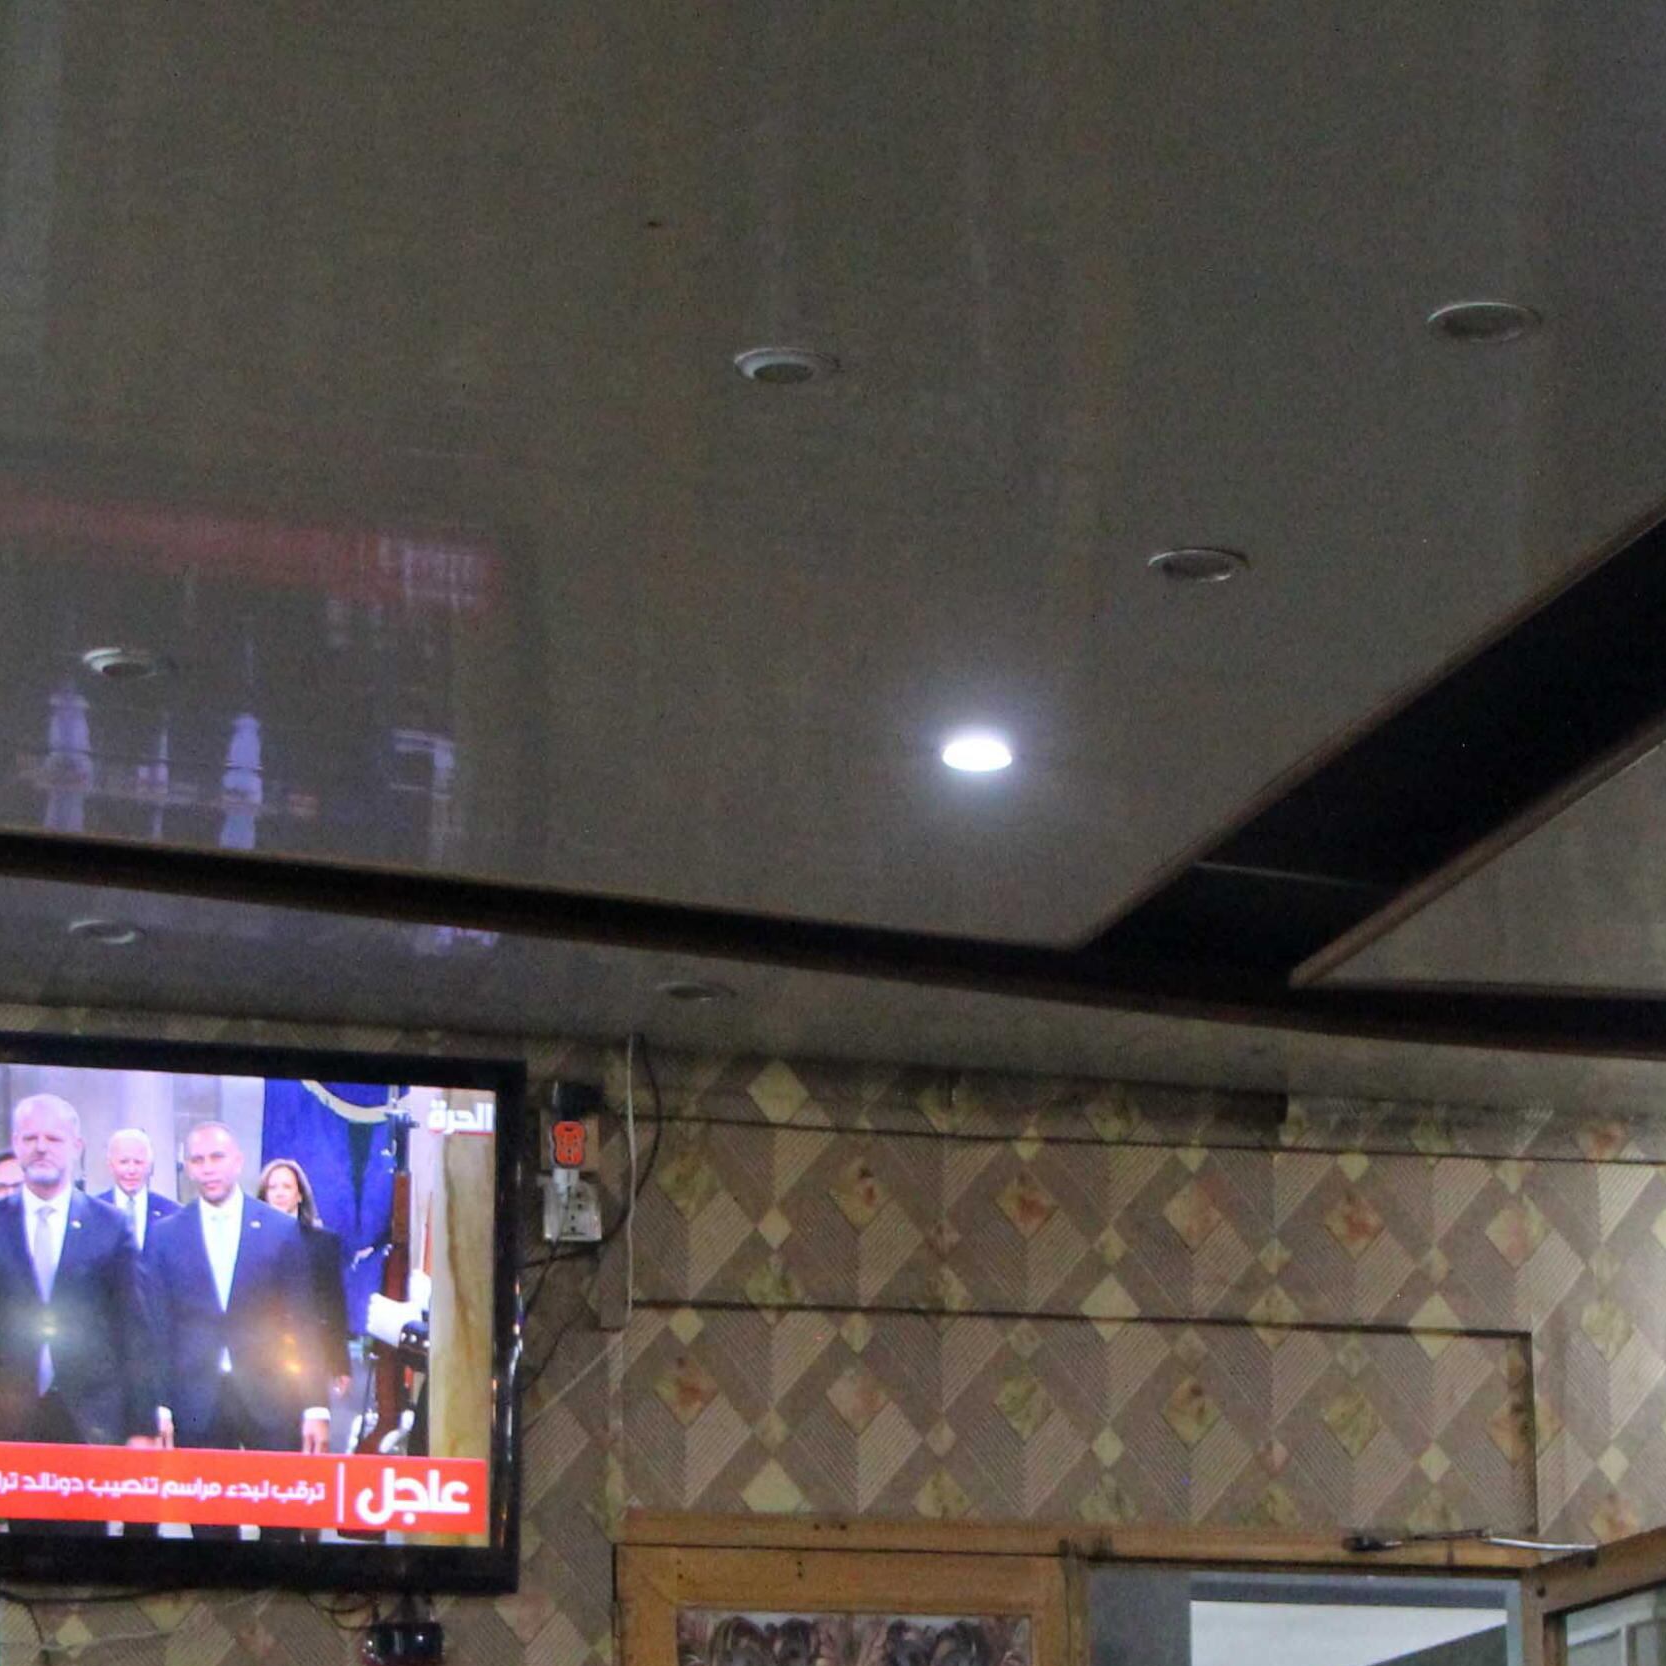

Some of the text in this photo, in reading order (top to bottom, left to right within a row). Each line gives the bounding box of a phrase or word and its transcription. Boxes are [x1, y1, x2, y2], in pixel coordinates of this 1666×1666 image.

[428, 1099, 495, 1135] الحرة
[23, 1471, 84, 1497] دونالد
[87, 1476, 159, 1499] تنصيب
[161, 1476, 222, 1501] مراسم
[224, 1479, 269, 1502] لبدء
[271, 1480, 326, 1505] ترقب
[355, 1467, 471, 1525] عاجل
